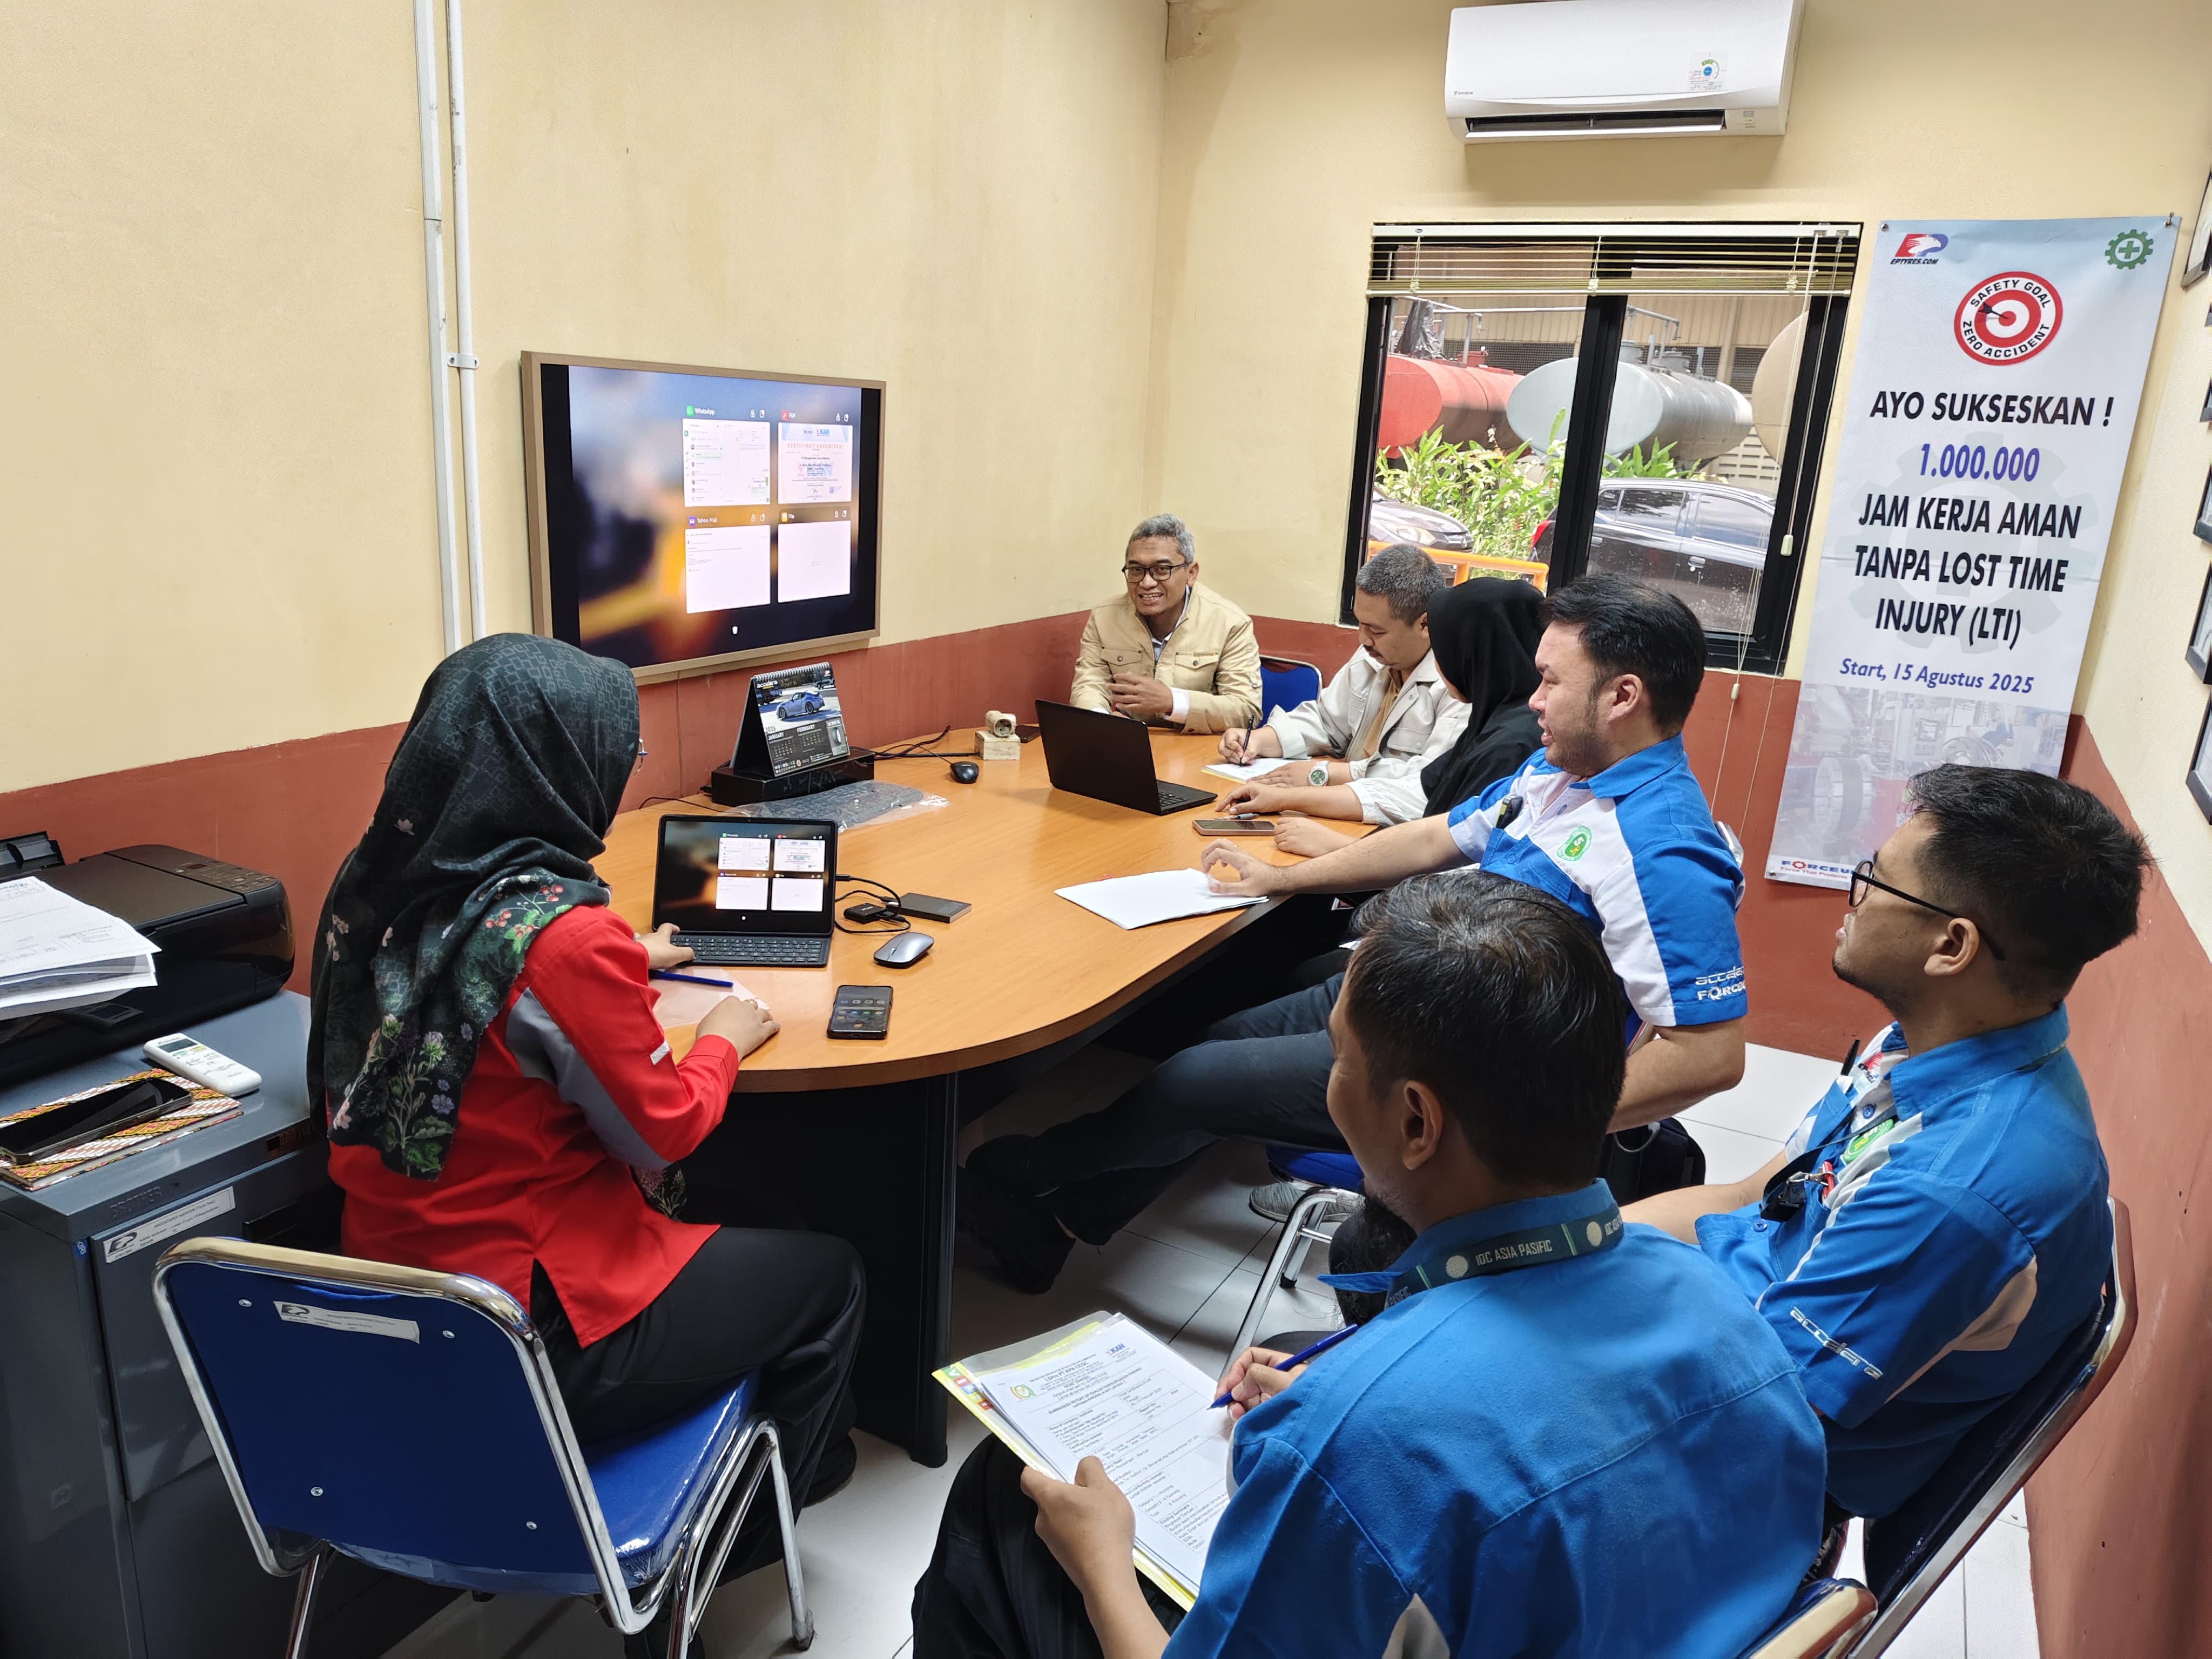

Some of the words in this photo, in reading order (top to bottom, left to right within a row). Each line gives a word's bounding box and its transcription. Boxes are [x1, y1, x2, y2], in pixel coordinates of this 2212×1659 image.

[1971, 280, 2020, 307] SAFETY
[2024, 282, 2051, 308] GOAL
[1963, 321, 1982, 350] ZERO
[1984, 324, 2050, 358] ACCIDENT
[1870, 391, 1924, 420] AYO
[1931, 392, 2095, 426] SUKSESKAN
[2102, 397, 2114, 427] !
[1920, 443, 2040, 482] 1.000.000
[1858, 494, 1909, 528] JAM
[1916, 496, 1990, 533] KERJA
[1997, 502, 2082, 539] AMAN
[1855, 545, 1930, 582] TANPA
[1938, 551, 2002, 586] LOST
[2008, 556, 2069, 592] TIME
[1875, 598, 1966, 636] INJURY
[1969, 606, 2021, 650] (LTI)
[1840, 658, 1886, 681] Start,
[1893, 663, 1913, 680] 15
[1915, 665, 1984, 689] Agustus
[1988, 673, 2034, 693] 2025
[768, 732, 784, 740] JANUARY
[1475, 1251, 1493, 1266] IQC
[1495, 1246, 1518, 1262] ASIA
[1518, 1239, 1553, 1257] PASIFIC
